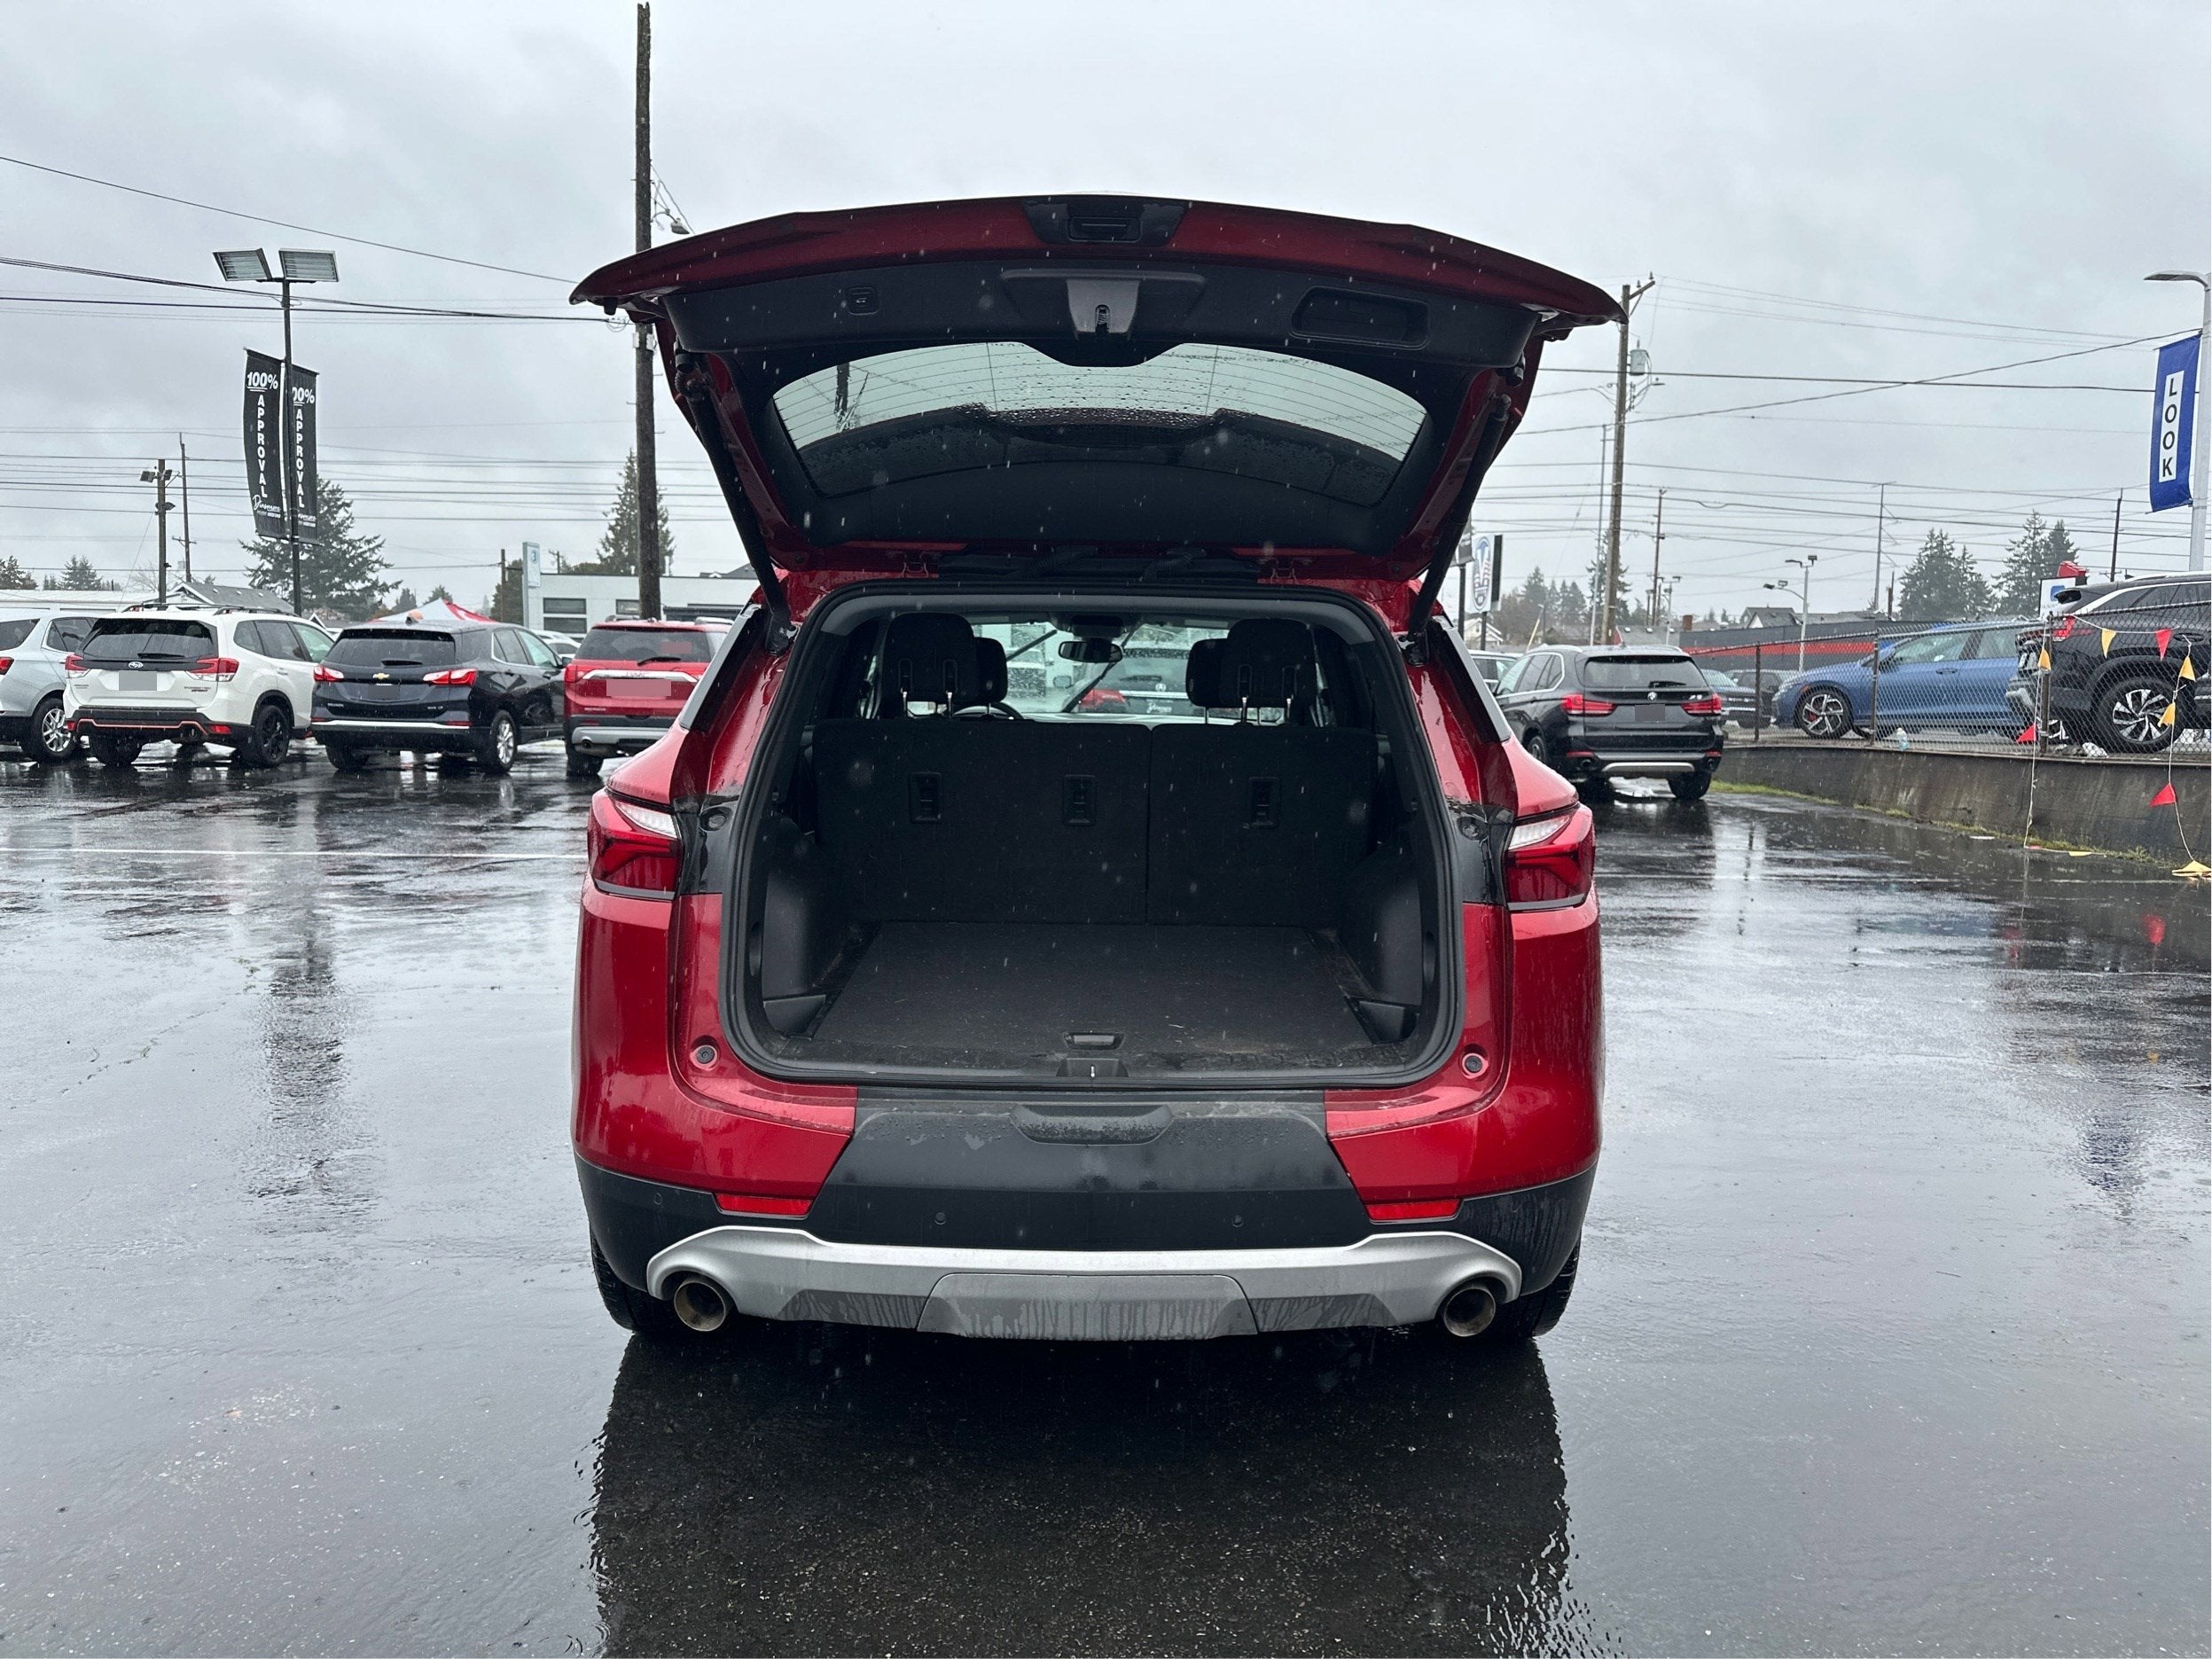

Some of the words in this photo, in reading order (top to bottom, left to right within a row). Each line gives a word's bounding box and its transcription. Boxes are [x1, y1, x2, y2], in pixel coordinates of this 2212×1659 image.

[246, 372, 278, 390] 100%
[292, 387, 316, 404] 00%
[2161, 378, 2178, 478] LOOK
[257, 394, 268, 498] APPROVAL
[295, 409, 305, 508] APPROVAL
